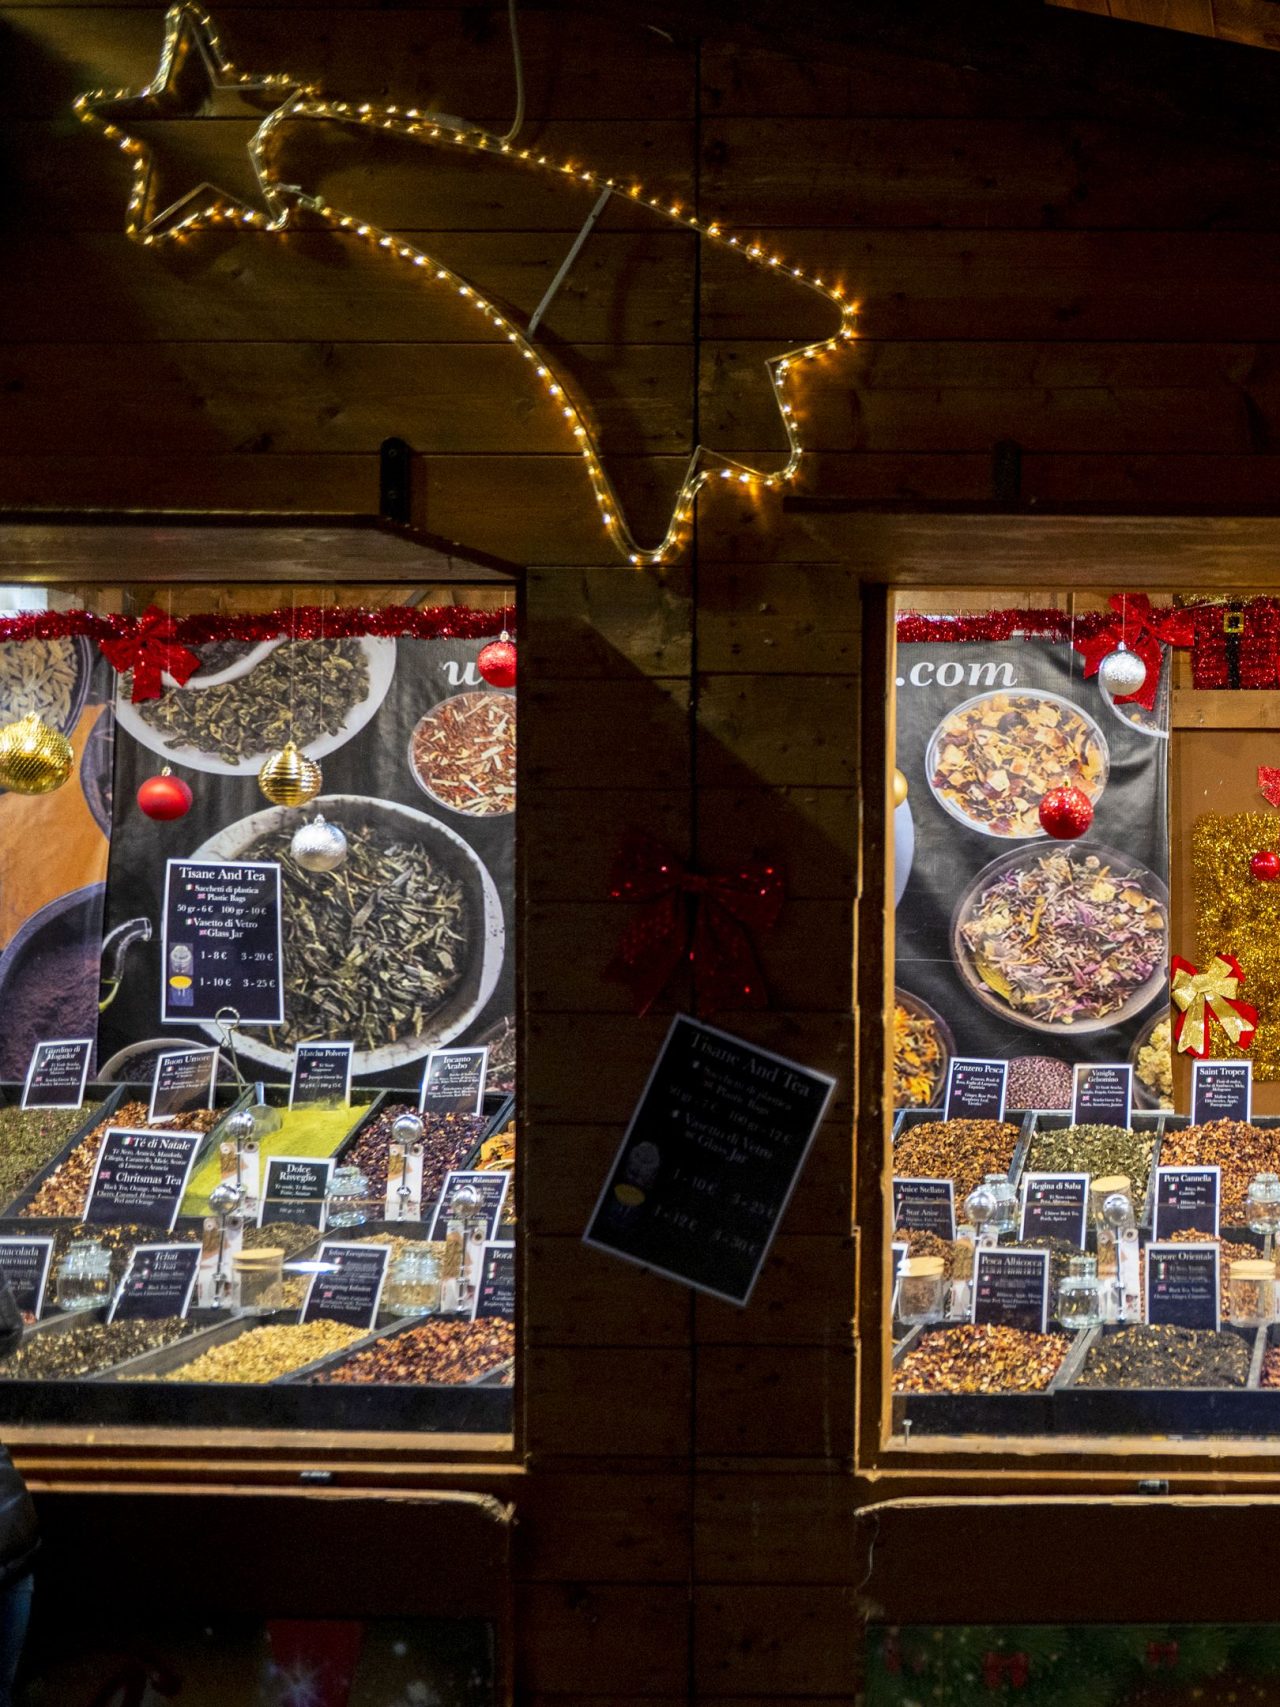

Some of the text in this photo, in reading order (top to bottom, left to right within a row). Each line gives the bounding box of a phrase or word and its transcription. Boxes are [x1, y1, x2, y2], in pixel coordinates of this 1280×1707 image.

[179, 866, 266, 882] Tisane And Tea
[195, 884, 259, 895] Sacchetti di plastica
[207, 893, 246, 902] Plastic Bags
[177, 904, 186, 912] 50
[221, 906, 234, 914] 100
[251, 907, 260, 915] 10
[193, 918, 258, 929] Vasetto di Vetro
[207, 929, 244, 940] Glass Jar
[213, 952, 219, 960] 8
[220, 951, 227, 960] €
[241, 952, 247, 961] 3
[254, 953, 266, 961] 20
[267, 953, 274, 961] €
[213, 978, 223, 986] 10
[225, 978, 232, 987] €
[243, 979, 249, 987] 3
[256, 979, 268, 988] 25
[269, 980, 276, 988] €
[325, 1049, 348, 1057] Polvere
[185, 1055, 210, 1063] Umore
[688, 1031, 812, 1096] Tisane And Tea
[954, 1063, 1004, 1073] Zenzero Pesca
[1199, 1068, 1246, 1077] Saint Tropez
[147, 1139, 158, 1148] di
[159, 1139, 191, 1150] Natale
[726, 1145, 749, 1167] Jar
[287, 1164, 311, 1173] Dolce
[116, 1171, 182, 1185] Chritsmas Tea
[279, 1171, 317, 1183] Risveglio
[1164, 1174, 1212, 1182] Pera Cannella
[1032, 1182, 1055, 1191] Regina
[1056, 1182, 1063, 1190] di
[982, 1256, 1002, 1265] Pesca
[1151, 1252, 1214, 1262] Sapore Orientale
